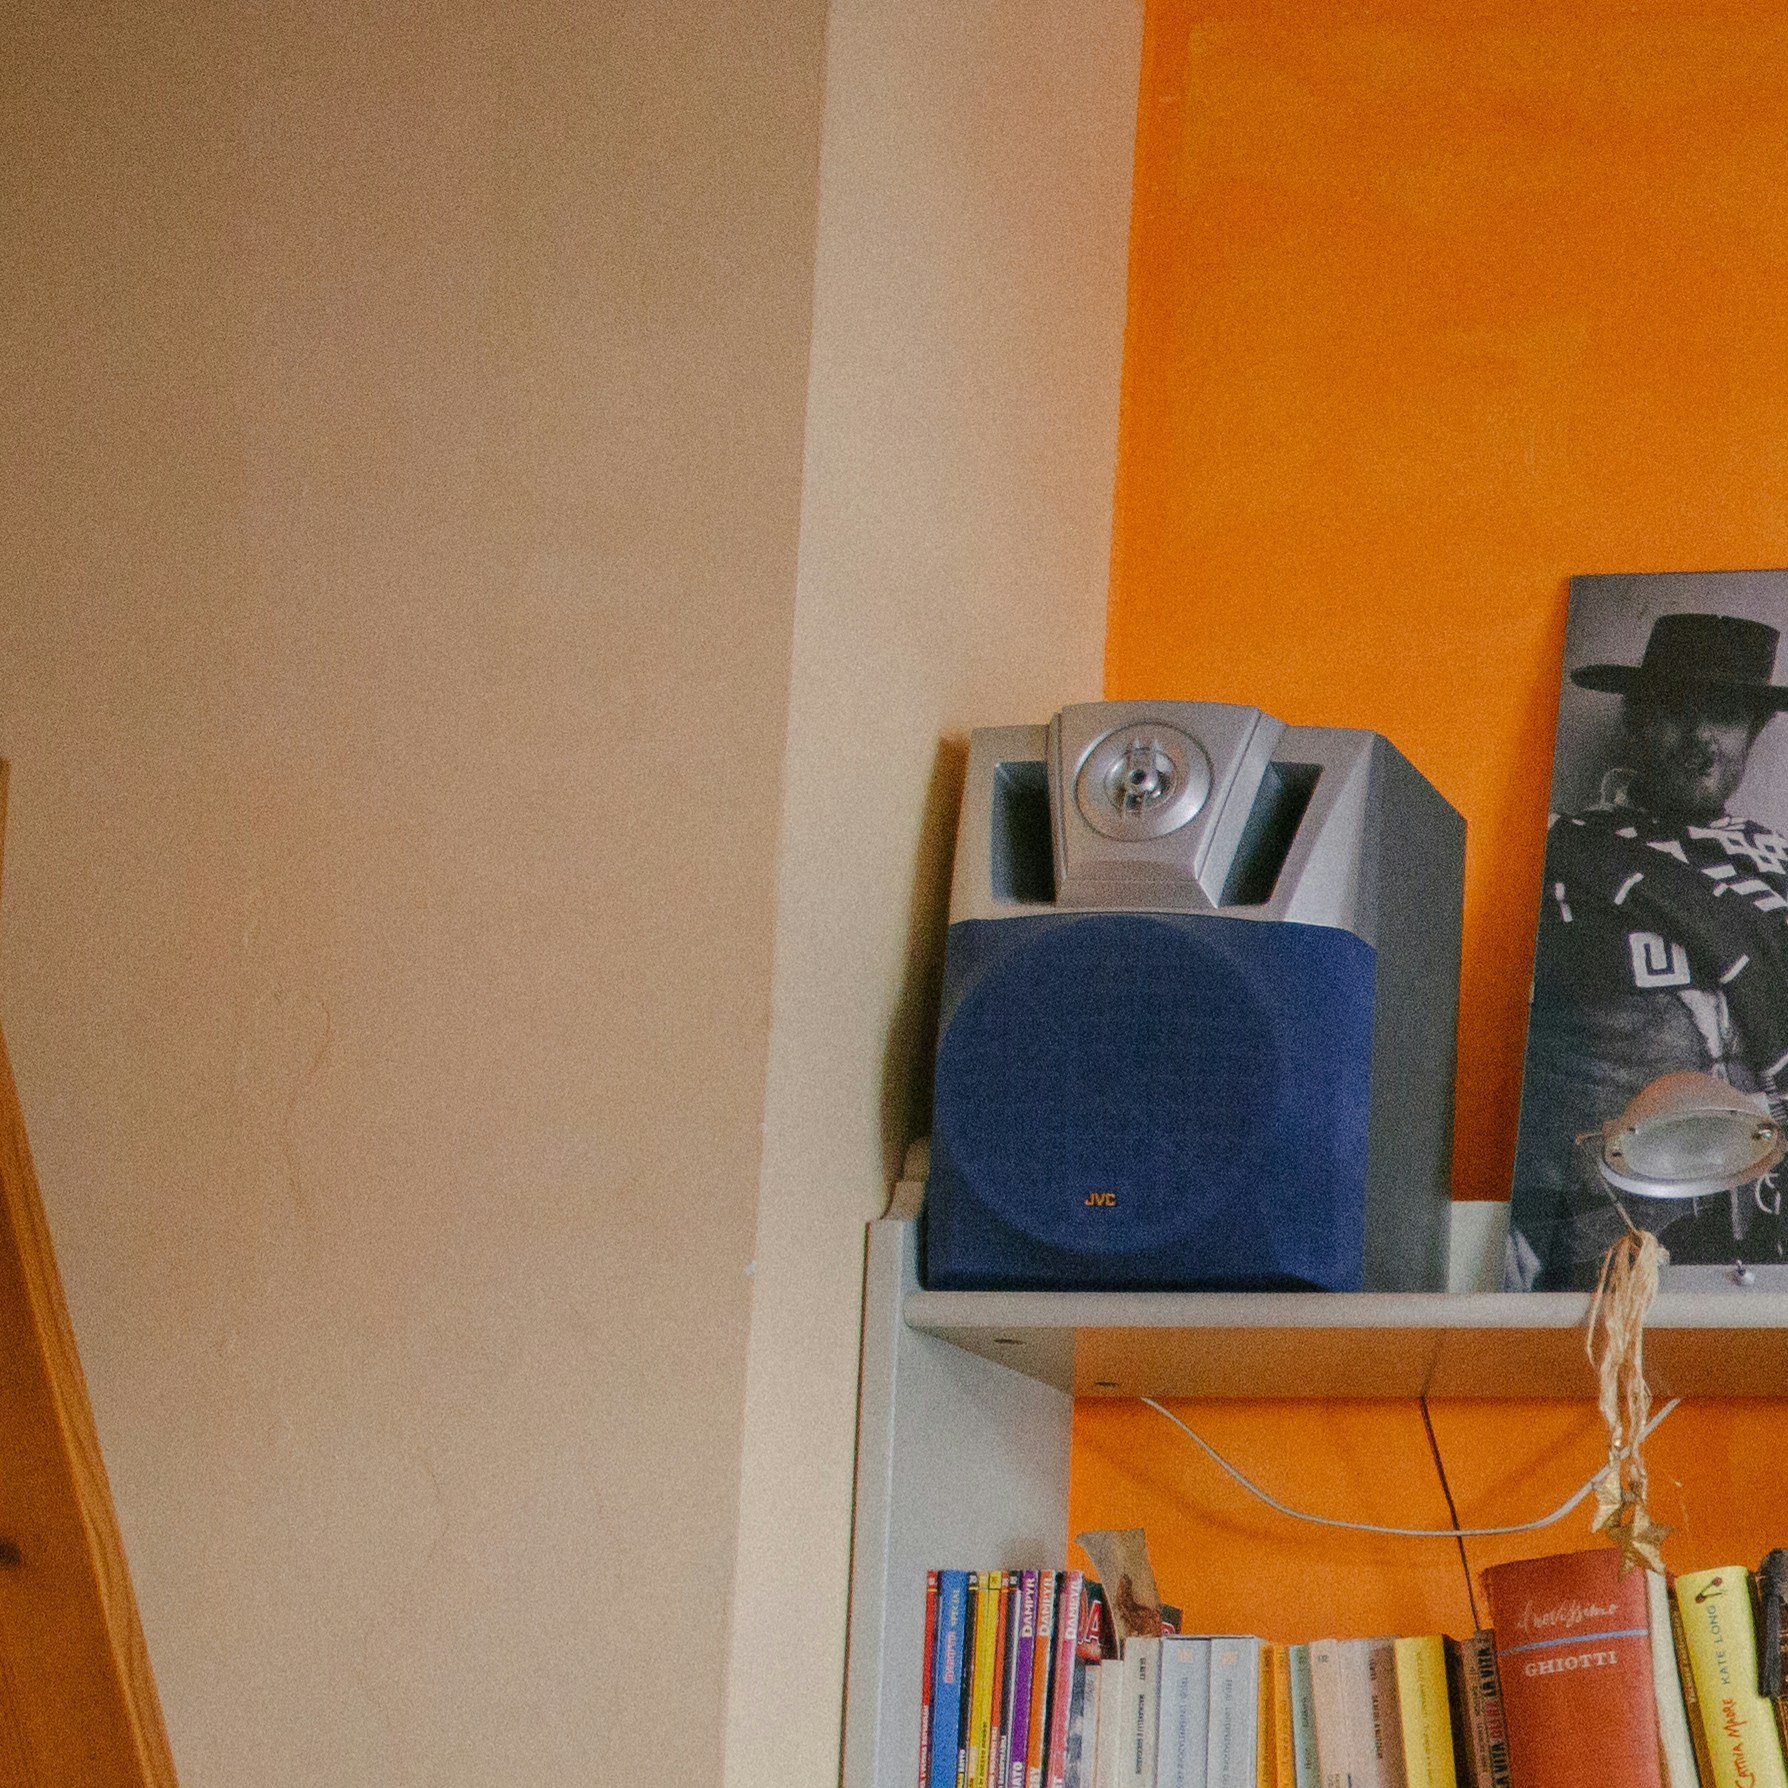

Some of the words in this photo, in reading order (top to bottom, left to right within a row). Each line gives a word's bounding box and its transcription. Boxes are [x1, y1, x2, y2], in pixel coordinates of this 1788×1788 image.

[1084, 1193, 1116, 1206] JVC
[1021, 1578, 1035, 1637] DAMPYR
[1039, 1578, 1052, 1636] DAMPYR
[1065, 1579, 1079, 1639] DAMPYR
[1706, 1605, 1723, 1644] LONG
[1524, 1651, 1617, 1677] GHIOTTI
[1716, 1647, 1732, 1685] KATE
